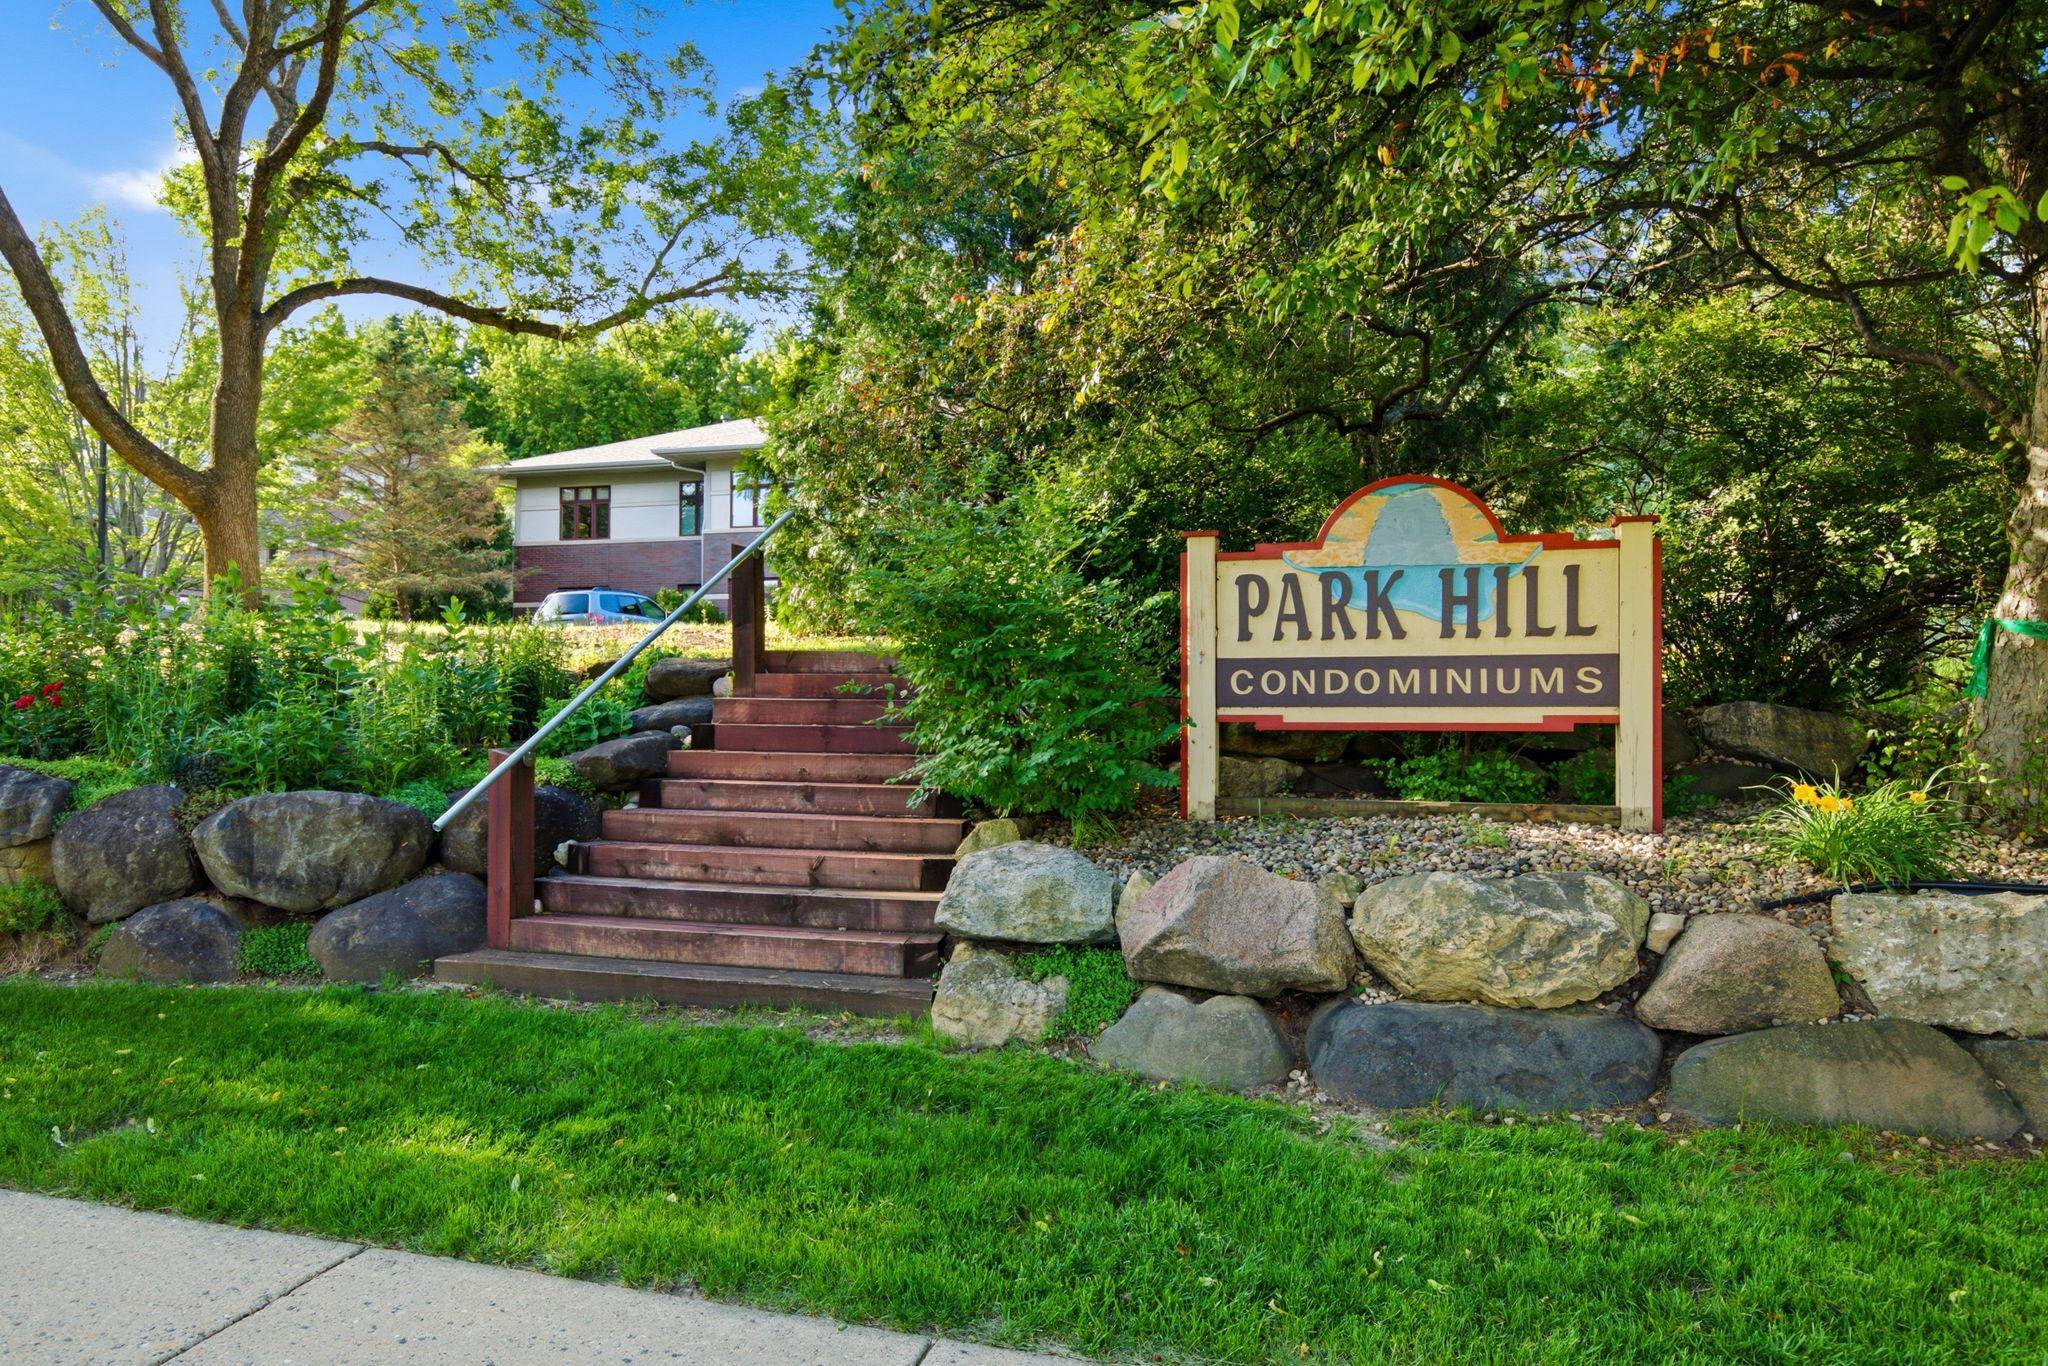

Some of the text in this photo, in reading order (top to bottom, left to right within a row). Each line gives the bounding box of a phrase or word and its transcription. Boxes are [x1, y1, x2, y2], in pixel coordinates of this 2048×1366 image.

[1235, 564, 1598, 642] PARK HILL
[1230, 666, 1604, 696] CONDOMINIUMS
